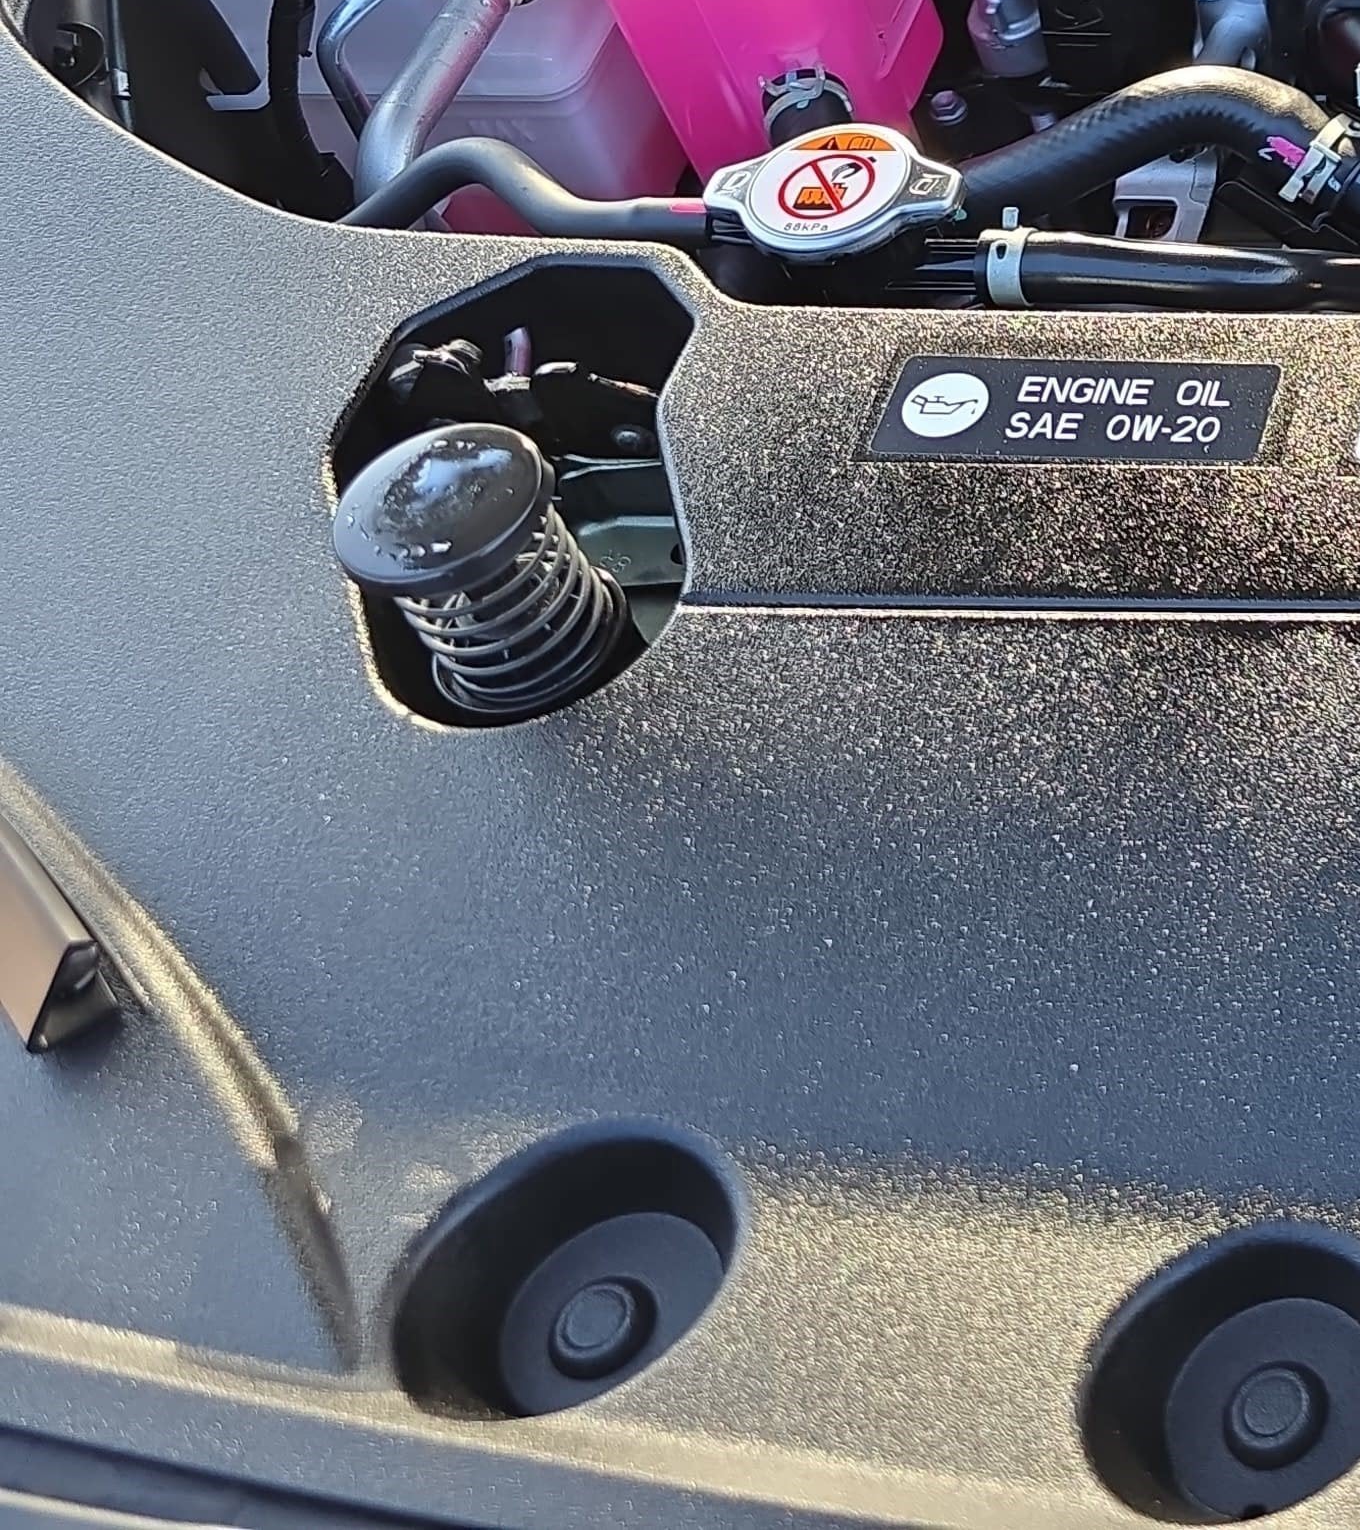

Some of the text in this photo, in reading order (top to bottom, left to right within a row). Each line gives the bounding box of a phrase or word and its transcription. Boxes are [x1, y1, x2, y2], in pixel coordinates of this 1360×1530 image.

[1017, 375, 1231, 407] ENGINE OIL
[1005, 412, 1221, 443] SAE 0W-20
